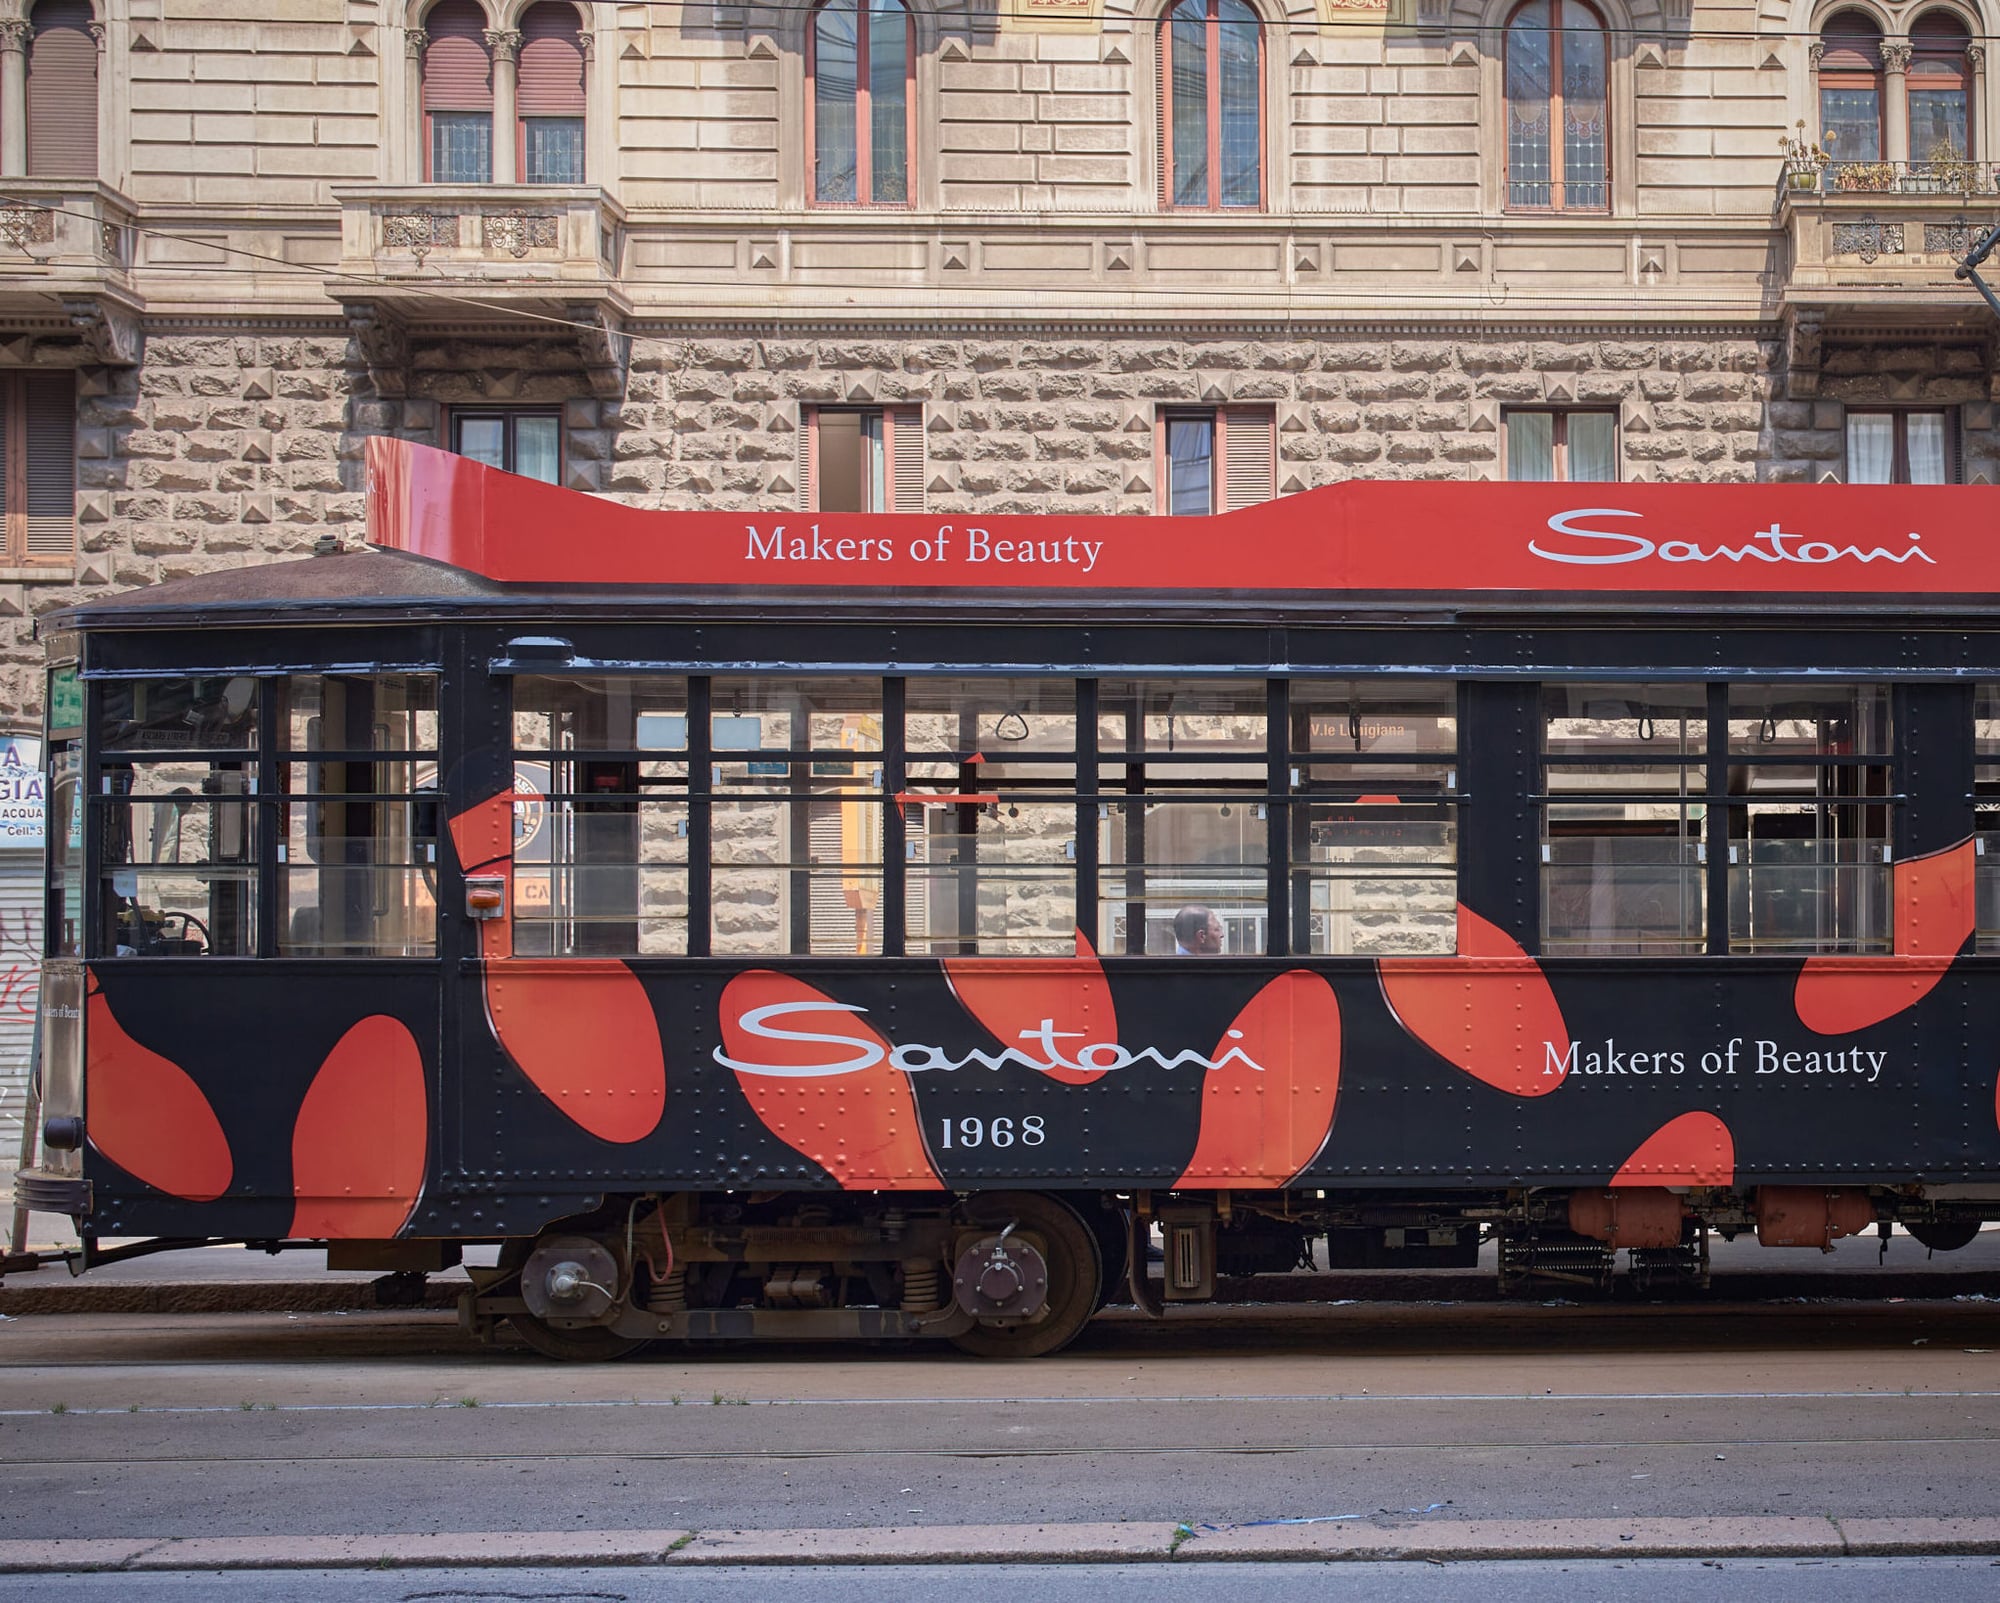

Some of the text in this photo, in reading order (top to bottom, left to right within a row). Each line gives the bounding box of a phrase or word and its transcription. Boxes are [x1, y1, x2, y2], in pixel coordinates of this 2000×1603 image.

[744, 524, 1105, 574] Makers of Beauty
[1527, 508, 1938, 566] Santoni
[1311, 723, 1336, 737] V.le
[2, 807, 43, 818] ACQUA
[7, 826, 33, 836] Cell.
[712, 1000, 1266, 1078] Santoni
[1542, 1038, 1888, 1082] Makers of Beauty
[941, 1115, 1045, 1149] 1968
